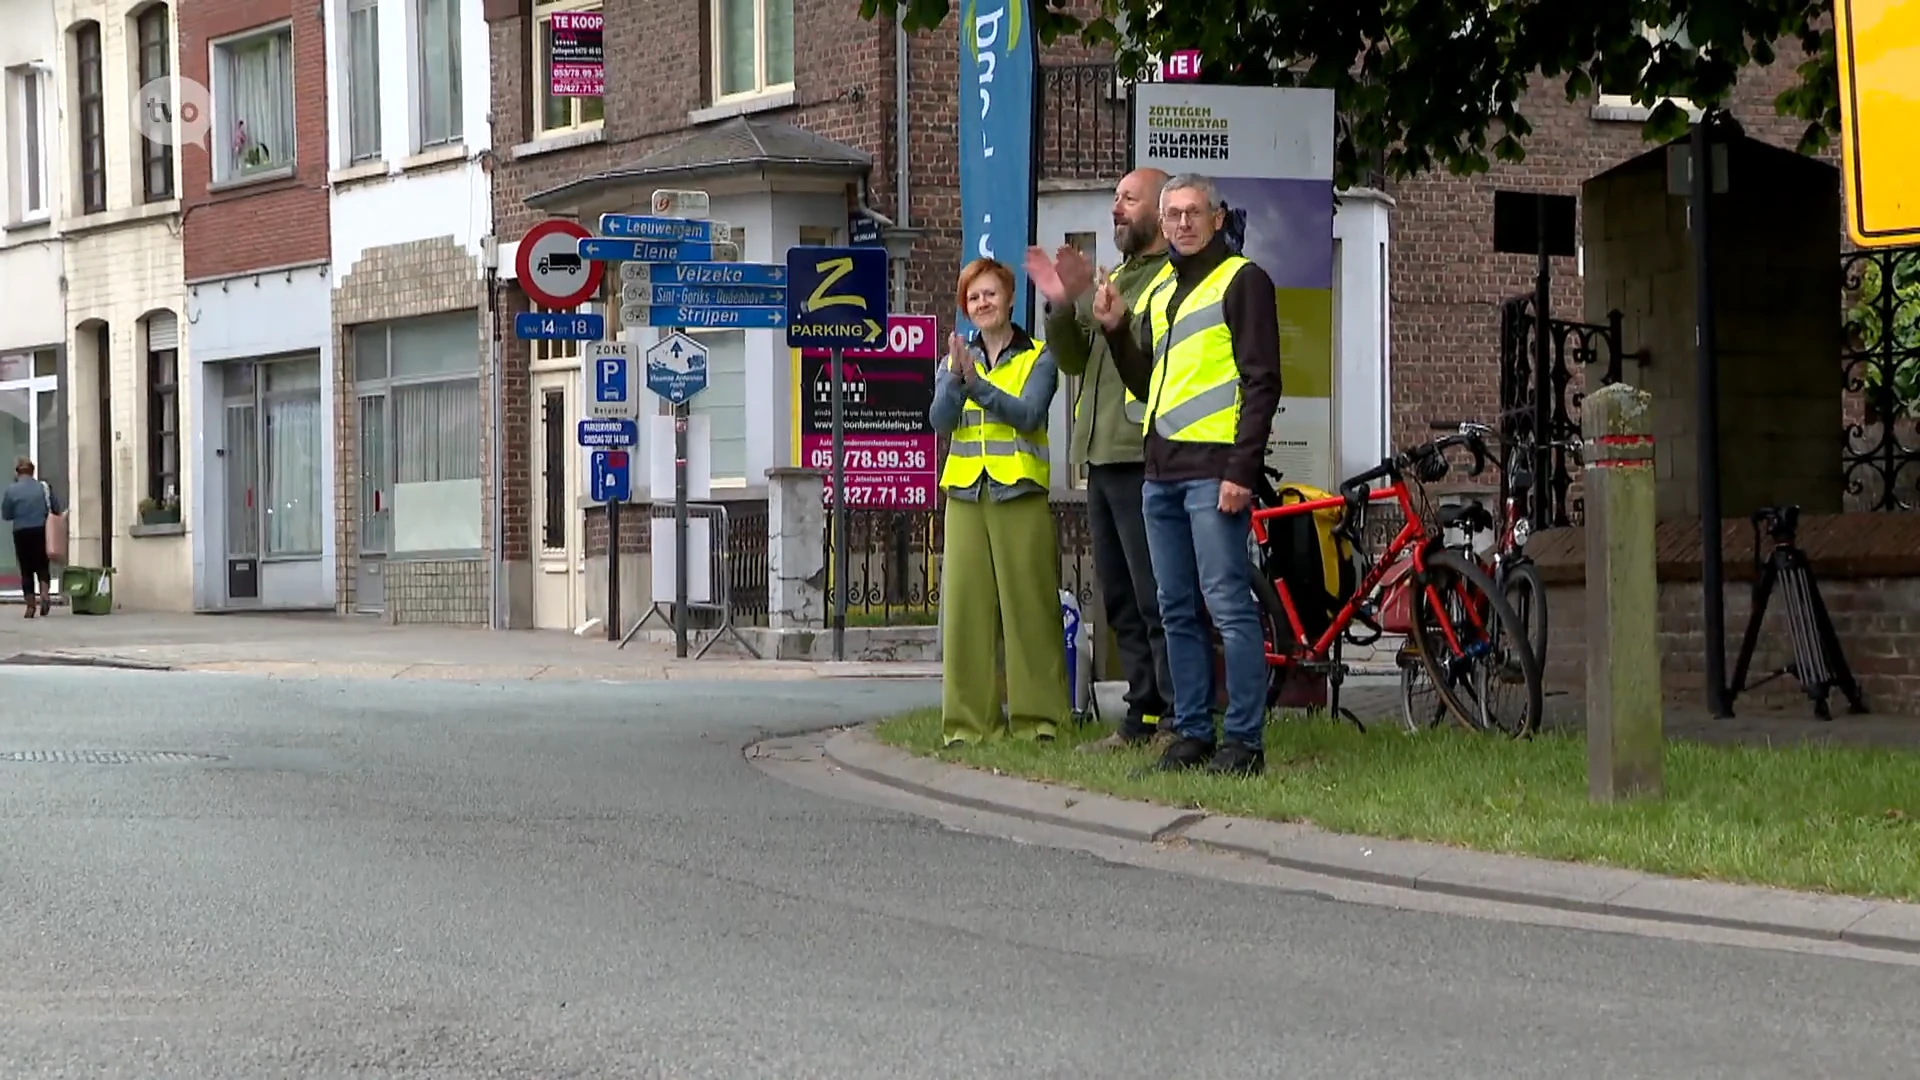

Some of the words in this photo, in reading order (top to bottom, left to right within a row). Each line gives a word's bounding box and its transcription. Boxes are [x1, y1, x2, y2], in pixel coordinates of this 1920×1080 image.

[554, 15, 568, 28] TE
[572, 16, 603, 29] KOOP
[1170, 56, 1188, 74] TE
[1149, 106, 1211, 117] ZOTTEGEM
[1159, 133, 1228, 146] VLAAMSE
[1149, 146, 1229, 159] ARDENNEN
[626, 219, 703, 240] Leeuwergem
[633, 243, 678, 259] Elene
[676, 266, 742, 282] Velzeke
[677, 305, 738, 325] Strijpen
[541, 319, 554, 334] 14
[571, 320, 587, 334] 18
[791, 324, 863, 336] PARKING
[596, 345, 627, 354] ZONE
[603, 361, 619, 384] P
[811, 450, 926, 469] 05/78.99.36
